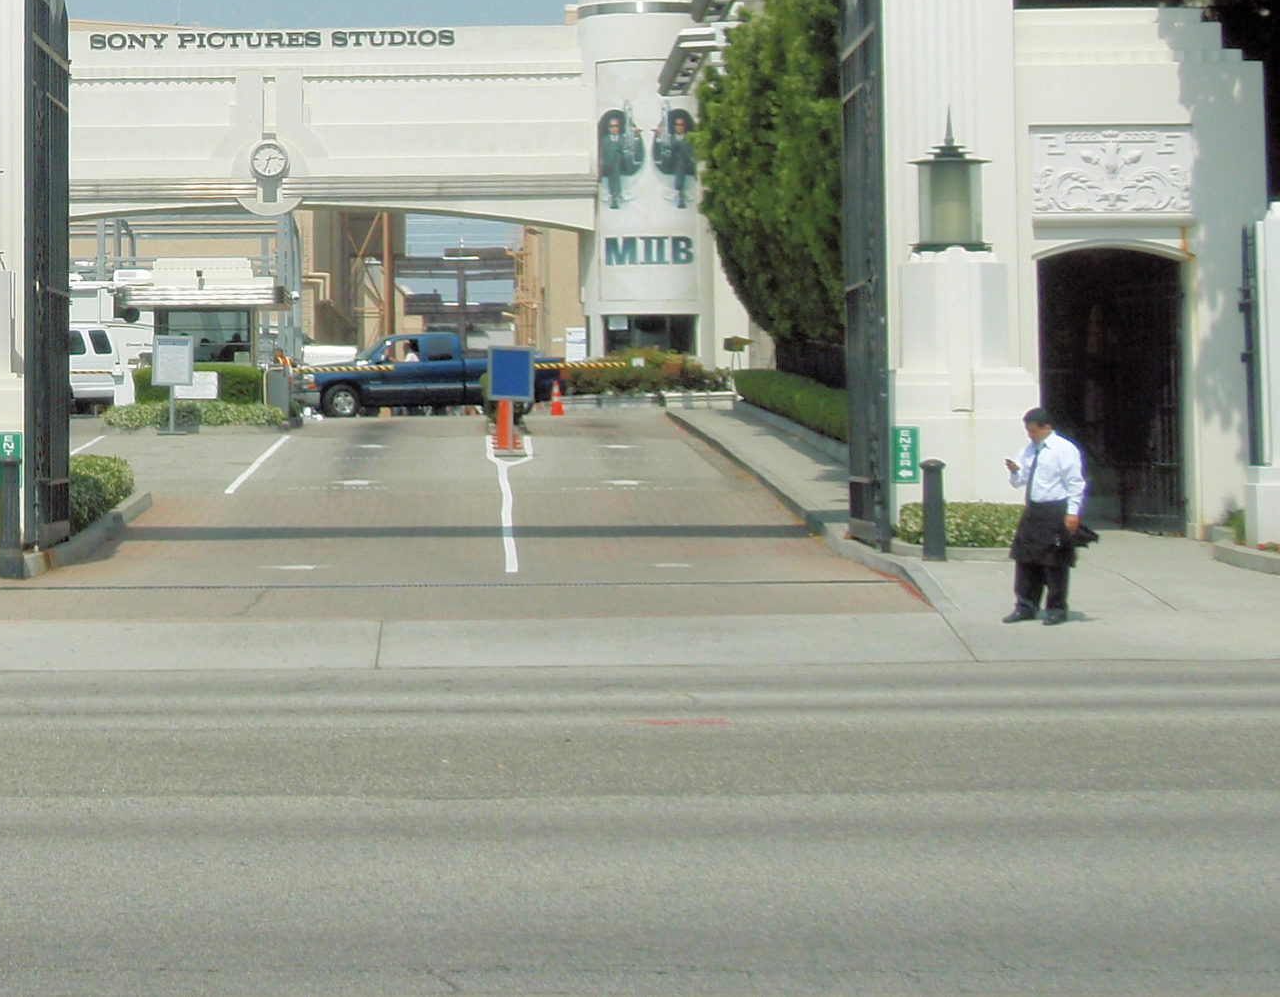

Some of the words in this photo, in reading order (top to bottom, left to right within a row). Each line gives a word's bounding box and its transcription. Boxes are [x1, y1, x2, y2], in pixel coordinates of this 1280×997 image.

[89, 33, 168, 51] SONY
[177, 31, 321, 49] PICTURES
[331, 29, 455, 47] STUDIOS
[604, 235, 694, 266] MIIB
[2, 435, 15, 456] ENT
[899, 429, 911, 466] ENTER
